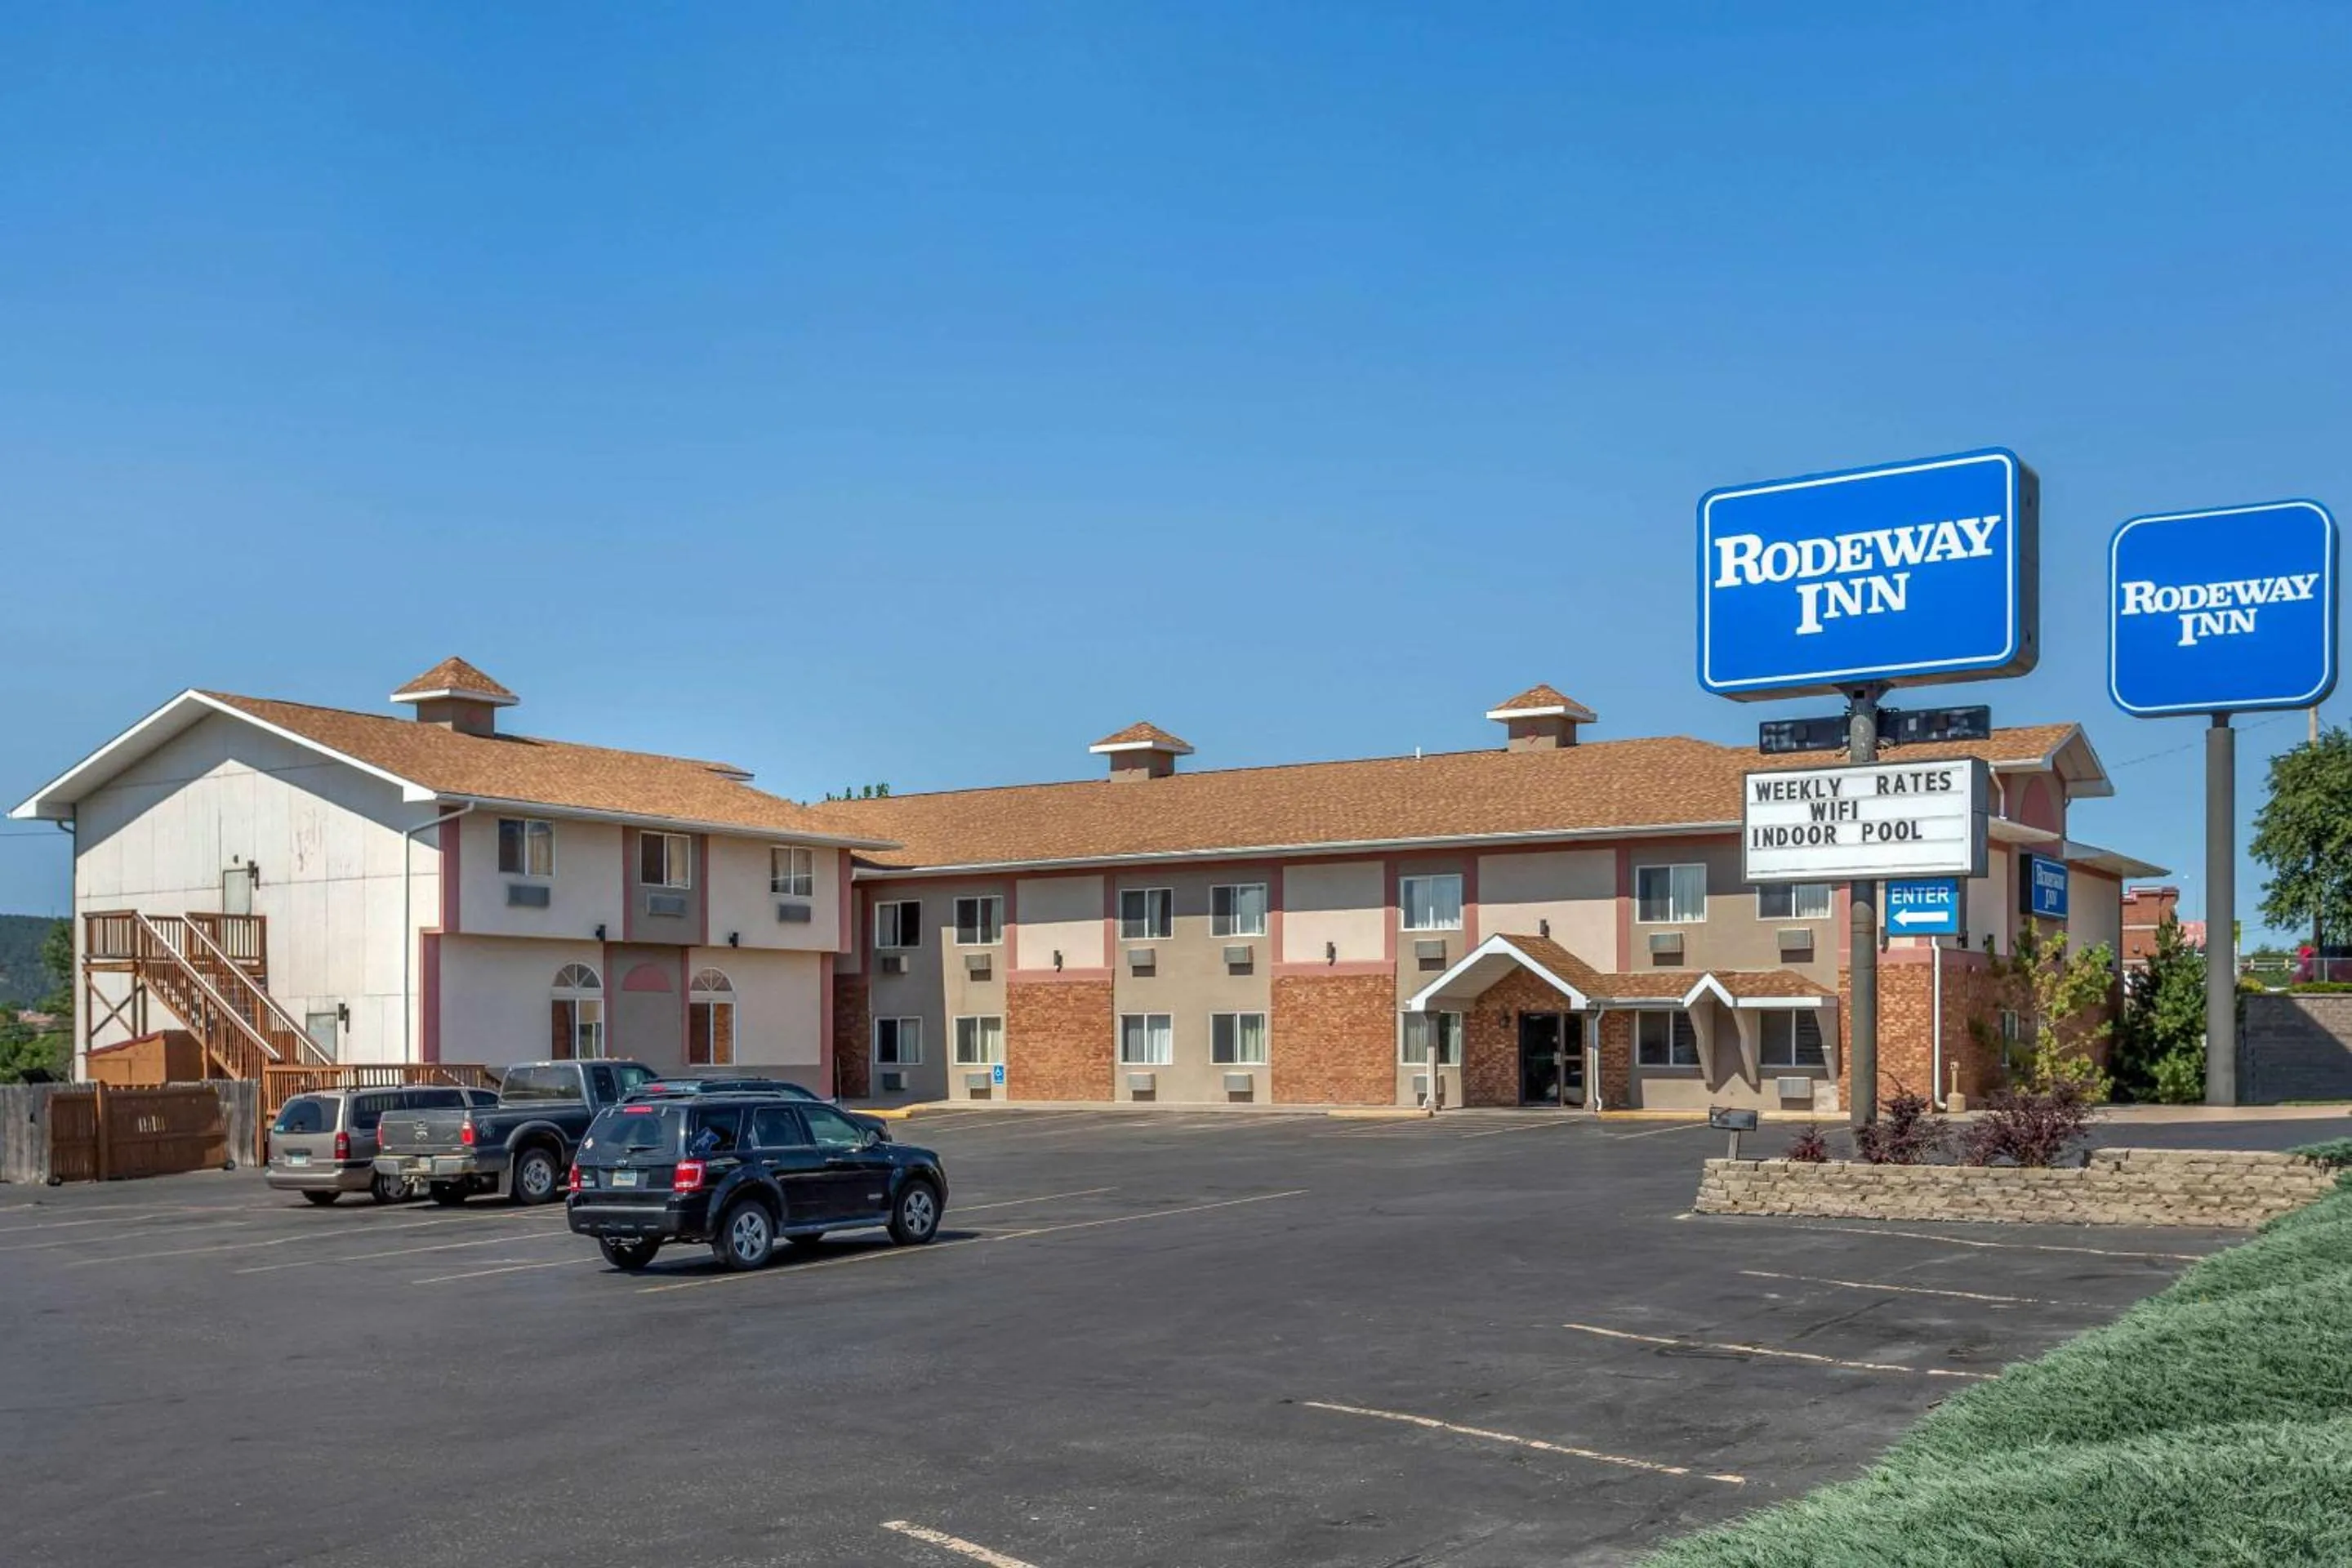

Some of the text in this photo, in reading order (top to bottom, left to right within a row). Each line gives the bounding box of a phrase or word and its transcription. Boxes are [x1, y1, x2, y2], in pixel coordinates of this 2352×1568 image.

[1713, 514, 2002, 589] RODEWAY
[1796, 573, 1910, 635] INN
[2121, 573, 2320, 616] RODEWAY
[2178, 608, 2257, 646] INN
[1755, 771, 1952, 801] WEEKLY RATES
[1810, 800, 1858, 822] WIFI
[1753, 821, 1922, 847] INDOOR POOL
[1891, 886, 1949, 905] ENTER
